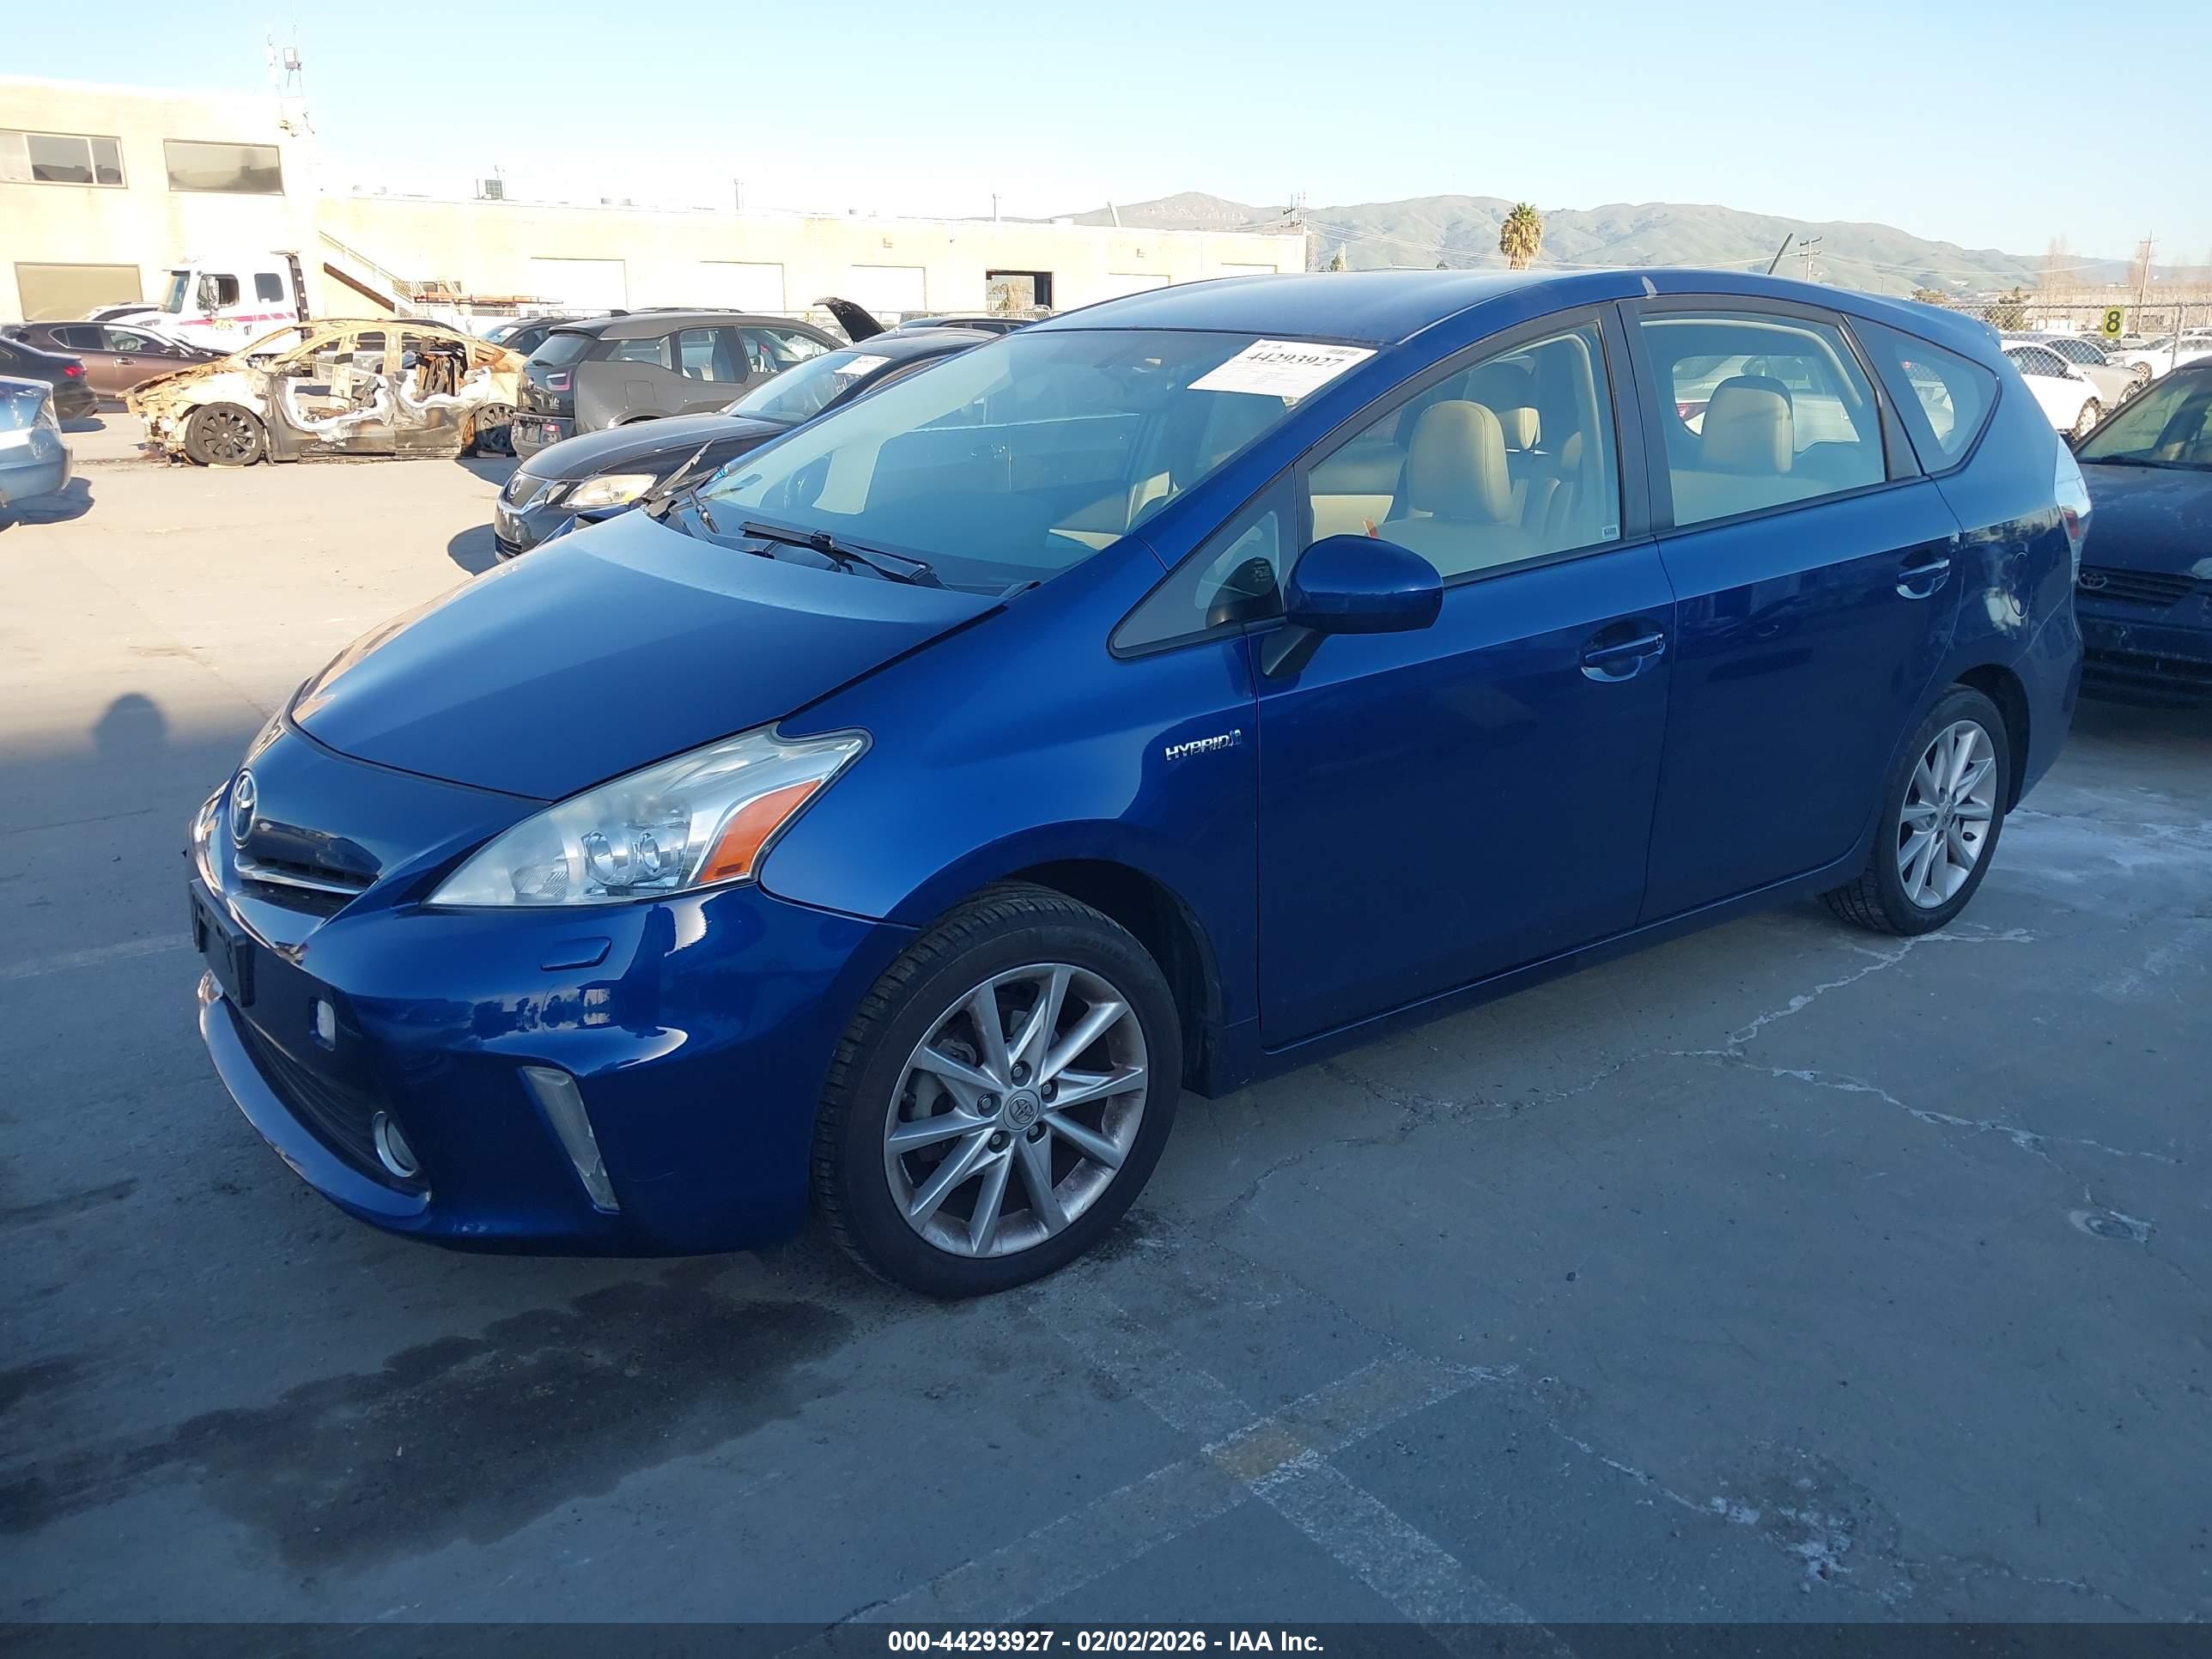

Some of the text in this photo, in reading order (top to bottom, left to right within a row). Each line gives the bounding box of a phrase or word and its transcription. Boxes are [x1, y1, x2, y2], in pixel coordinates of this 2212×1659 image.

[2106, 310, 2121, 333] 8
[1247, 351, 1346, 368] 44293927
[1165, 733, 1231, 761] HYBRID
